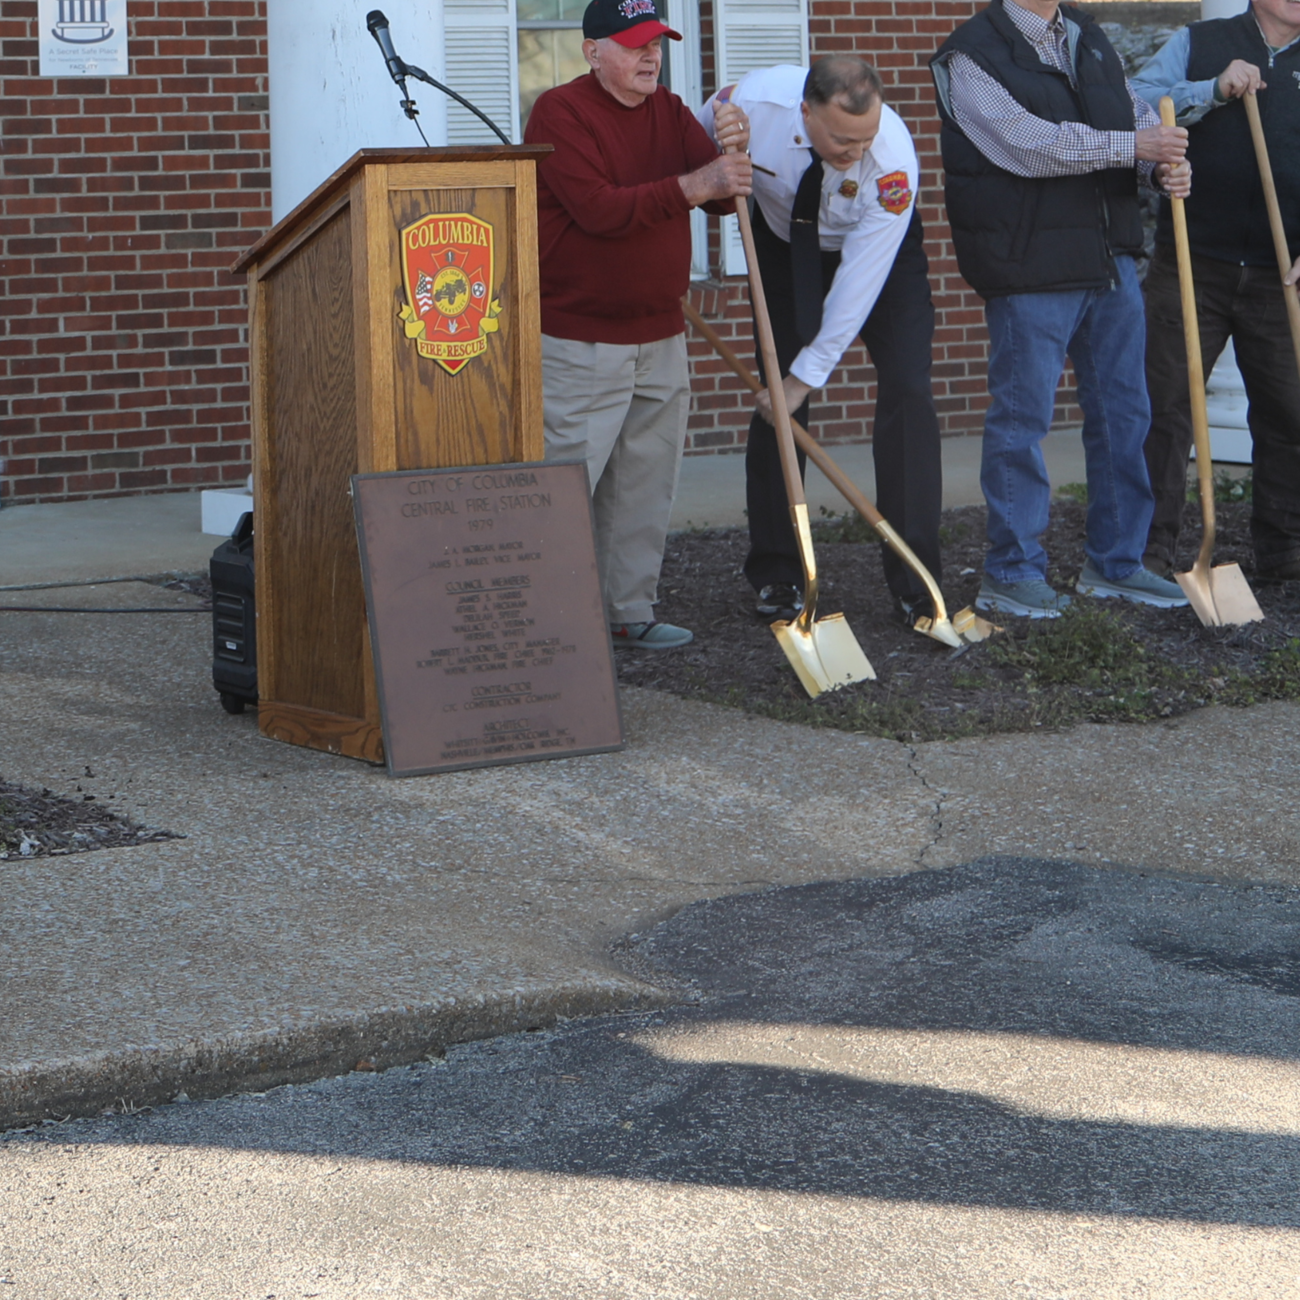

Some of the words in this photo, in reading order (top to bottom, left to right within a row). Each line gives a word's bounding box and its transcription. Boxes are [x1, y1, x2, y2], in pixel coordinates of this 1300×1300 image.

[99, 47, 118, 55] Place
[408, 221, 488, 250] COLUMBIA
[419, 342, 443, 357] FIRE
[447, 338, 485, 357] RESCUE
[407, 479, 436, 496] CITY
[445, 476, 464, 493] OF
[472, 472, 539, 491] COLUMBIA
[400, 500, 459, 518] CENTRAL
[465, 497, 491, 513] FIRE
[499, 492, 552, 511] STATION
[467, 518, 494, 532] 1979
[427, 559, 452, 570] JAMES
[493, 554, 511, 564] VICE
[517, 552, 542, 562] MAYOR
[445, 578, 485, 591] COUNCIL
[490, 575, 531, 588] MEMBERS
[457, 593, 481, 604] JAMES
[496, 590, 523, 601] HARRIS
[501, 628, 526, 638] WHITE
[502, 641, 519, 651] CITY
[471, 681, 532, 697] CONTRACTOR
[463, 697, 521, 710] CONSTRUCTION
[525, 692, 562, 704] COMPANY
[483, 718, 530, 732] ARCHITECT
